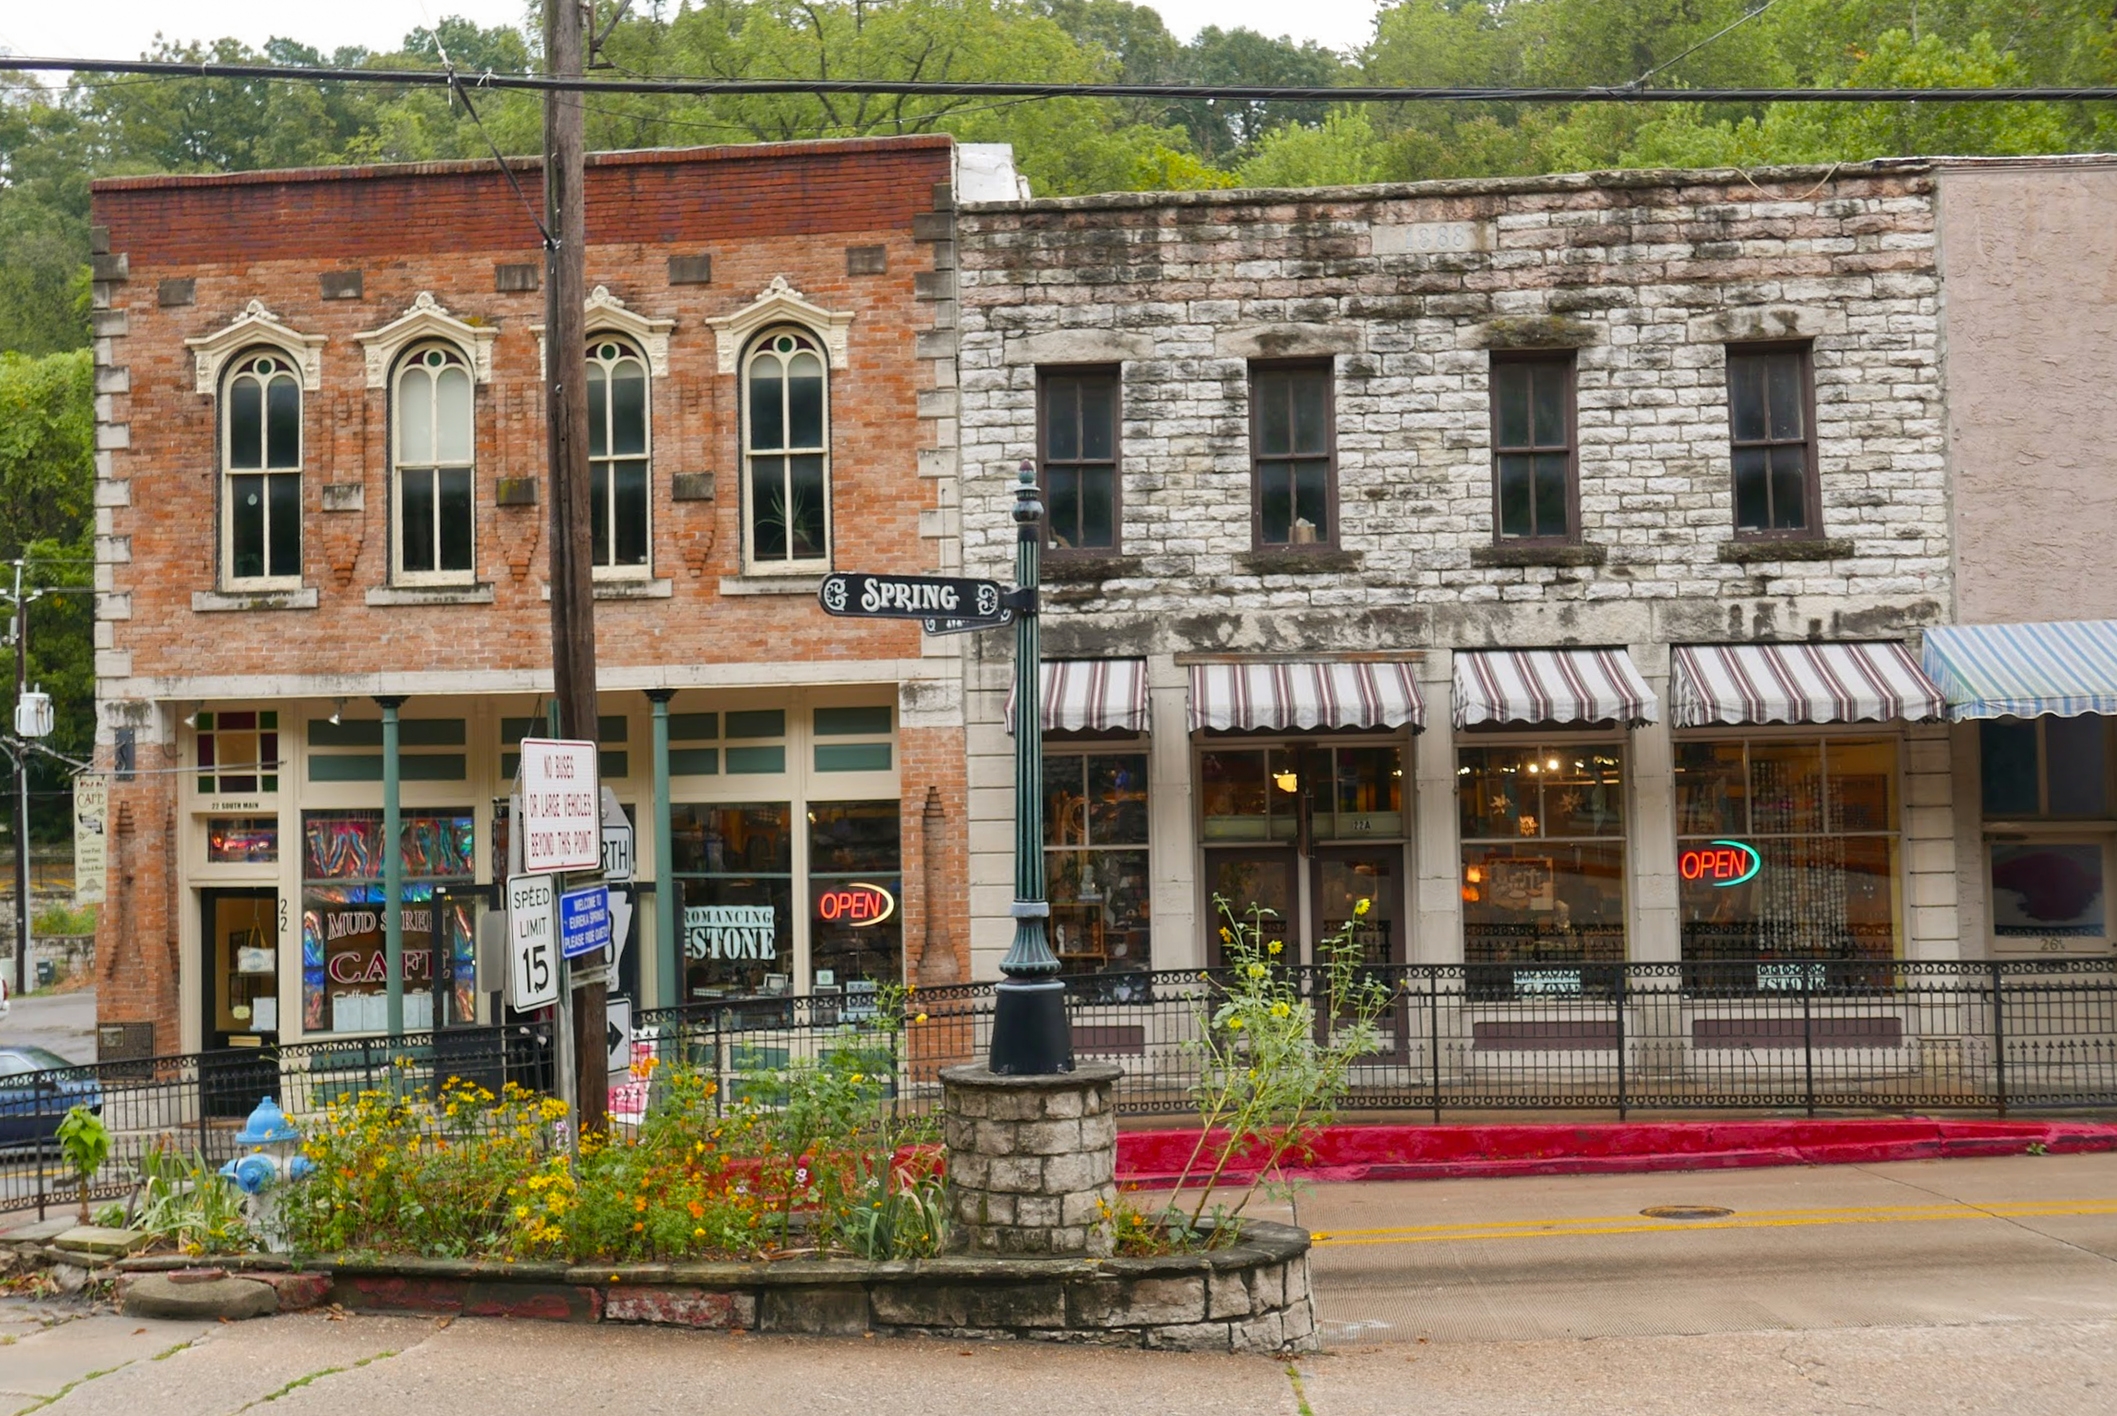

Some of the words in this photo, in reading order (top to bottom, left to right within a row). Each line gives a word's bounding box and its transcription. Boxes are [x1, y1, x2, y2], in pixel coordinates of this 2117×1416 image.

[1405, 225, 1465, 249] 1888
[861, 577, 960, 612] SPRING
[544, 755, 553, 779] NO
[556, 755, 574, 779] BUSES
[212, 802, 219, 810] 22
[222, 802, 241, 810] SOUTH
[243, 802, 259, 810] MAIN
[530, 793, 539, 817] OR
[541, 793, 560, 817] LARGE
[563, 793, 591, 817] VEHICLES
[531, 832, 554, 857] BEYOND
[558, 831, 571, 855] THIS
[575, 830, 591, 854] POINT
[603, 840, 628, 870] RTH
[1681, 850, 1747, 879] OPEN
[514, 887, 550, 909] SPEED
[574, 896, 596, 912] WELCOME
[820, 892, 881, 919] OPEN
[327, 911, 376, 940] MUD
[520, 917, 547, 938] LIMIT
[569, 913, 589, 930] EUREKA
[685, 910, 771, 924] ROMANCING
[564, 932, 585, 950] PLEASE
[692, 927, 776, 960] STONE
[522, 945, 549, 994] 15
